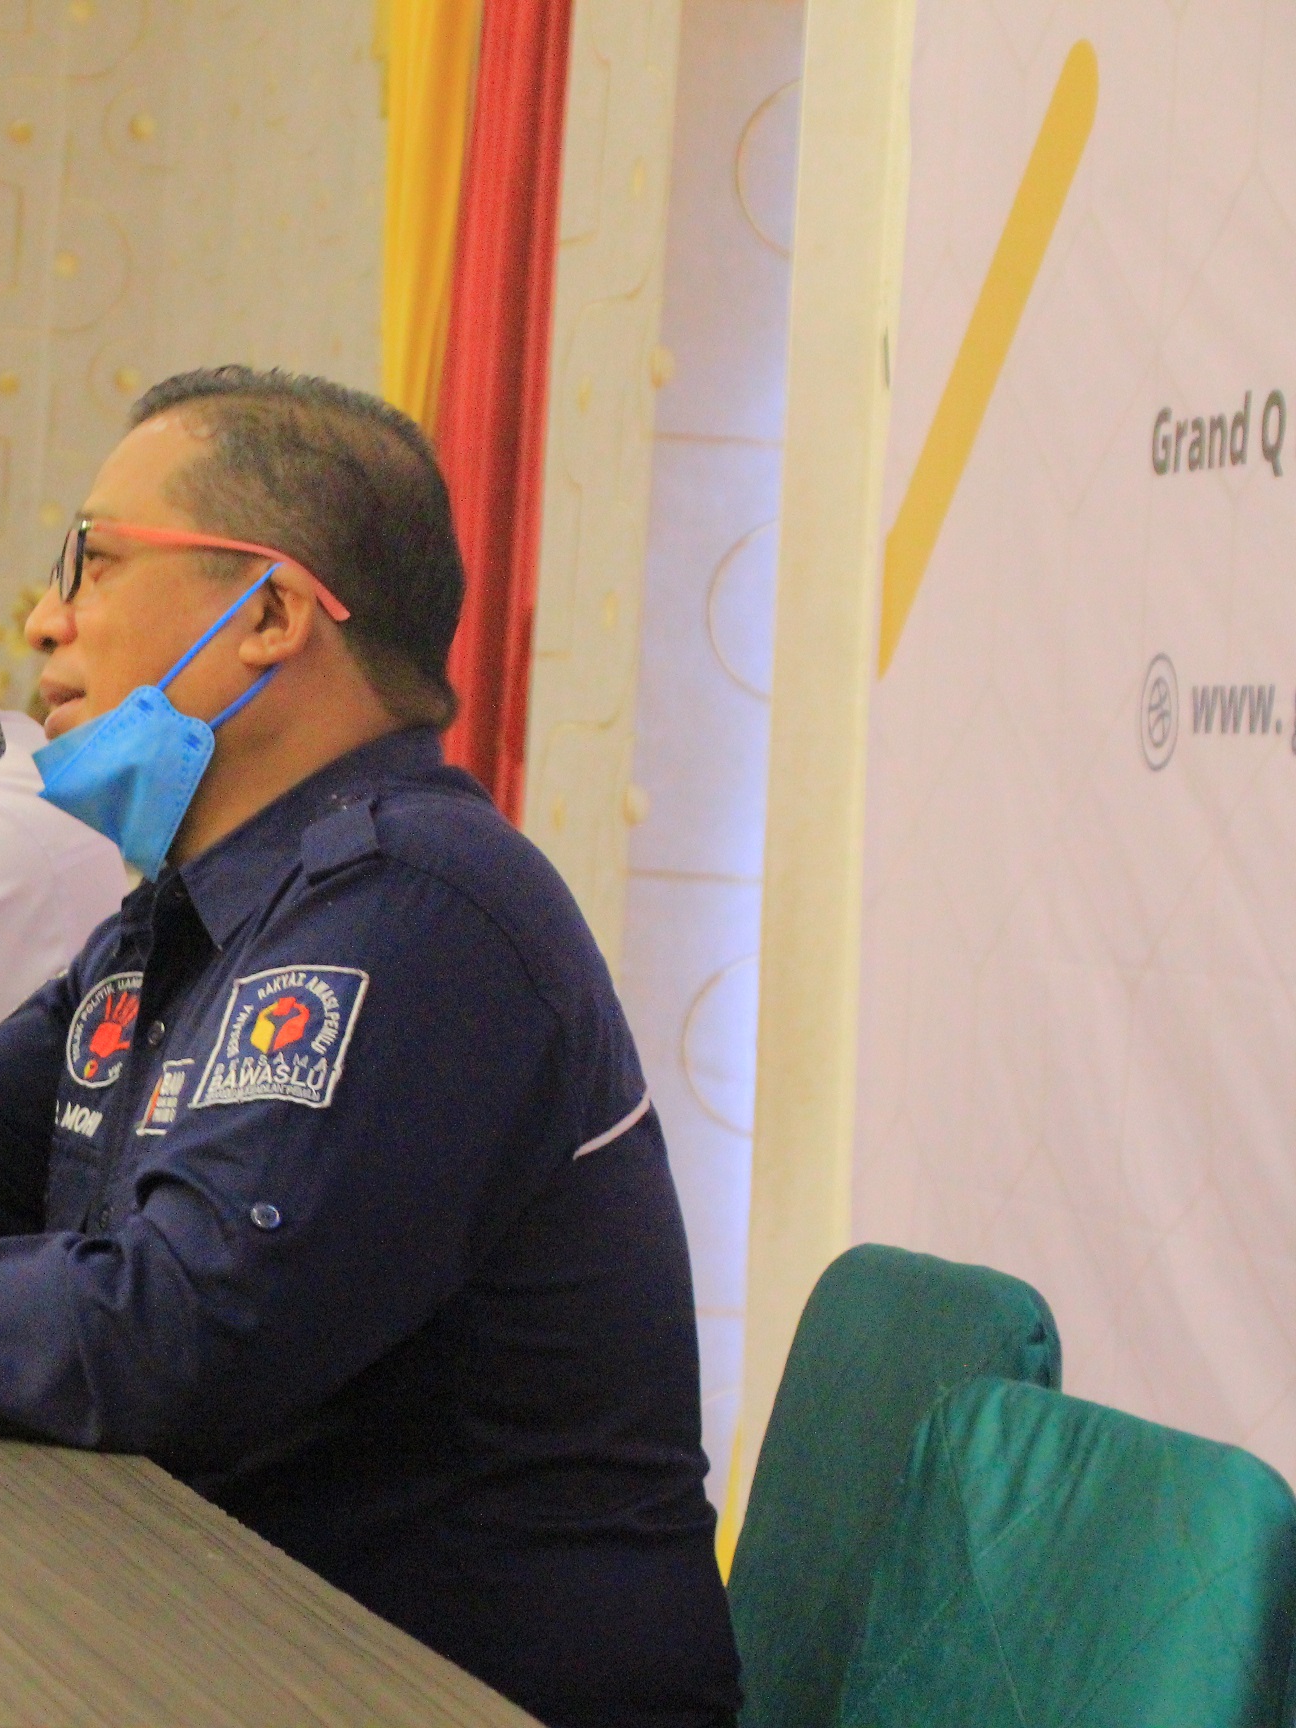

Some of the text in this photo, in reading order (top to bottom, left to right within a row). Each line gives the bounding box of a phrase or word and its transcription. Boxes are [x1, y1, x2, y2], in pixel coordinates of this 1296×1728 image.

[1152, 389, 1286, 477] Grand Q
[208, 1062, 329, 1093] BAWASLU
